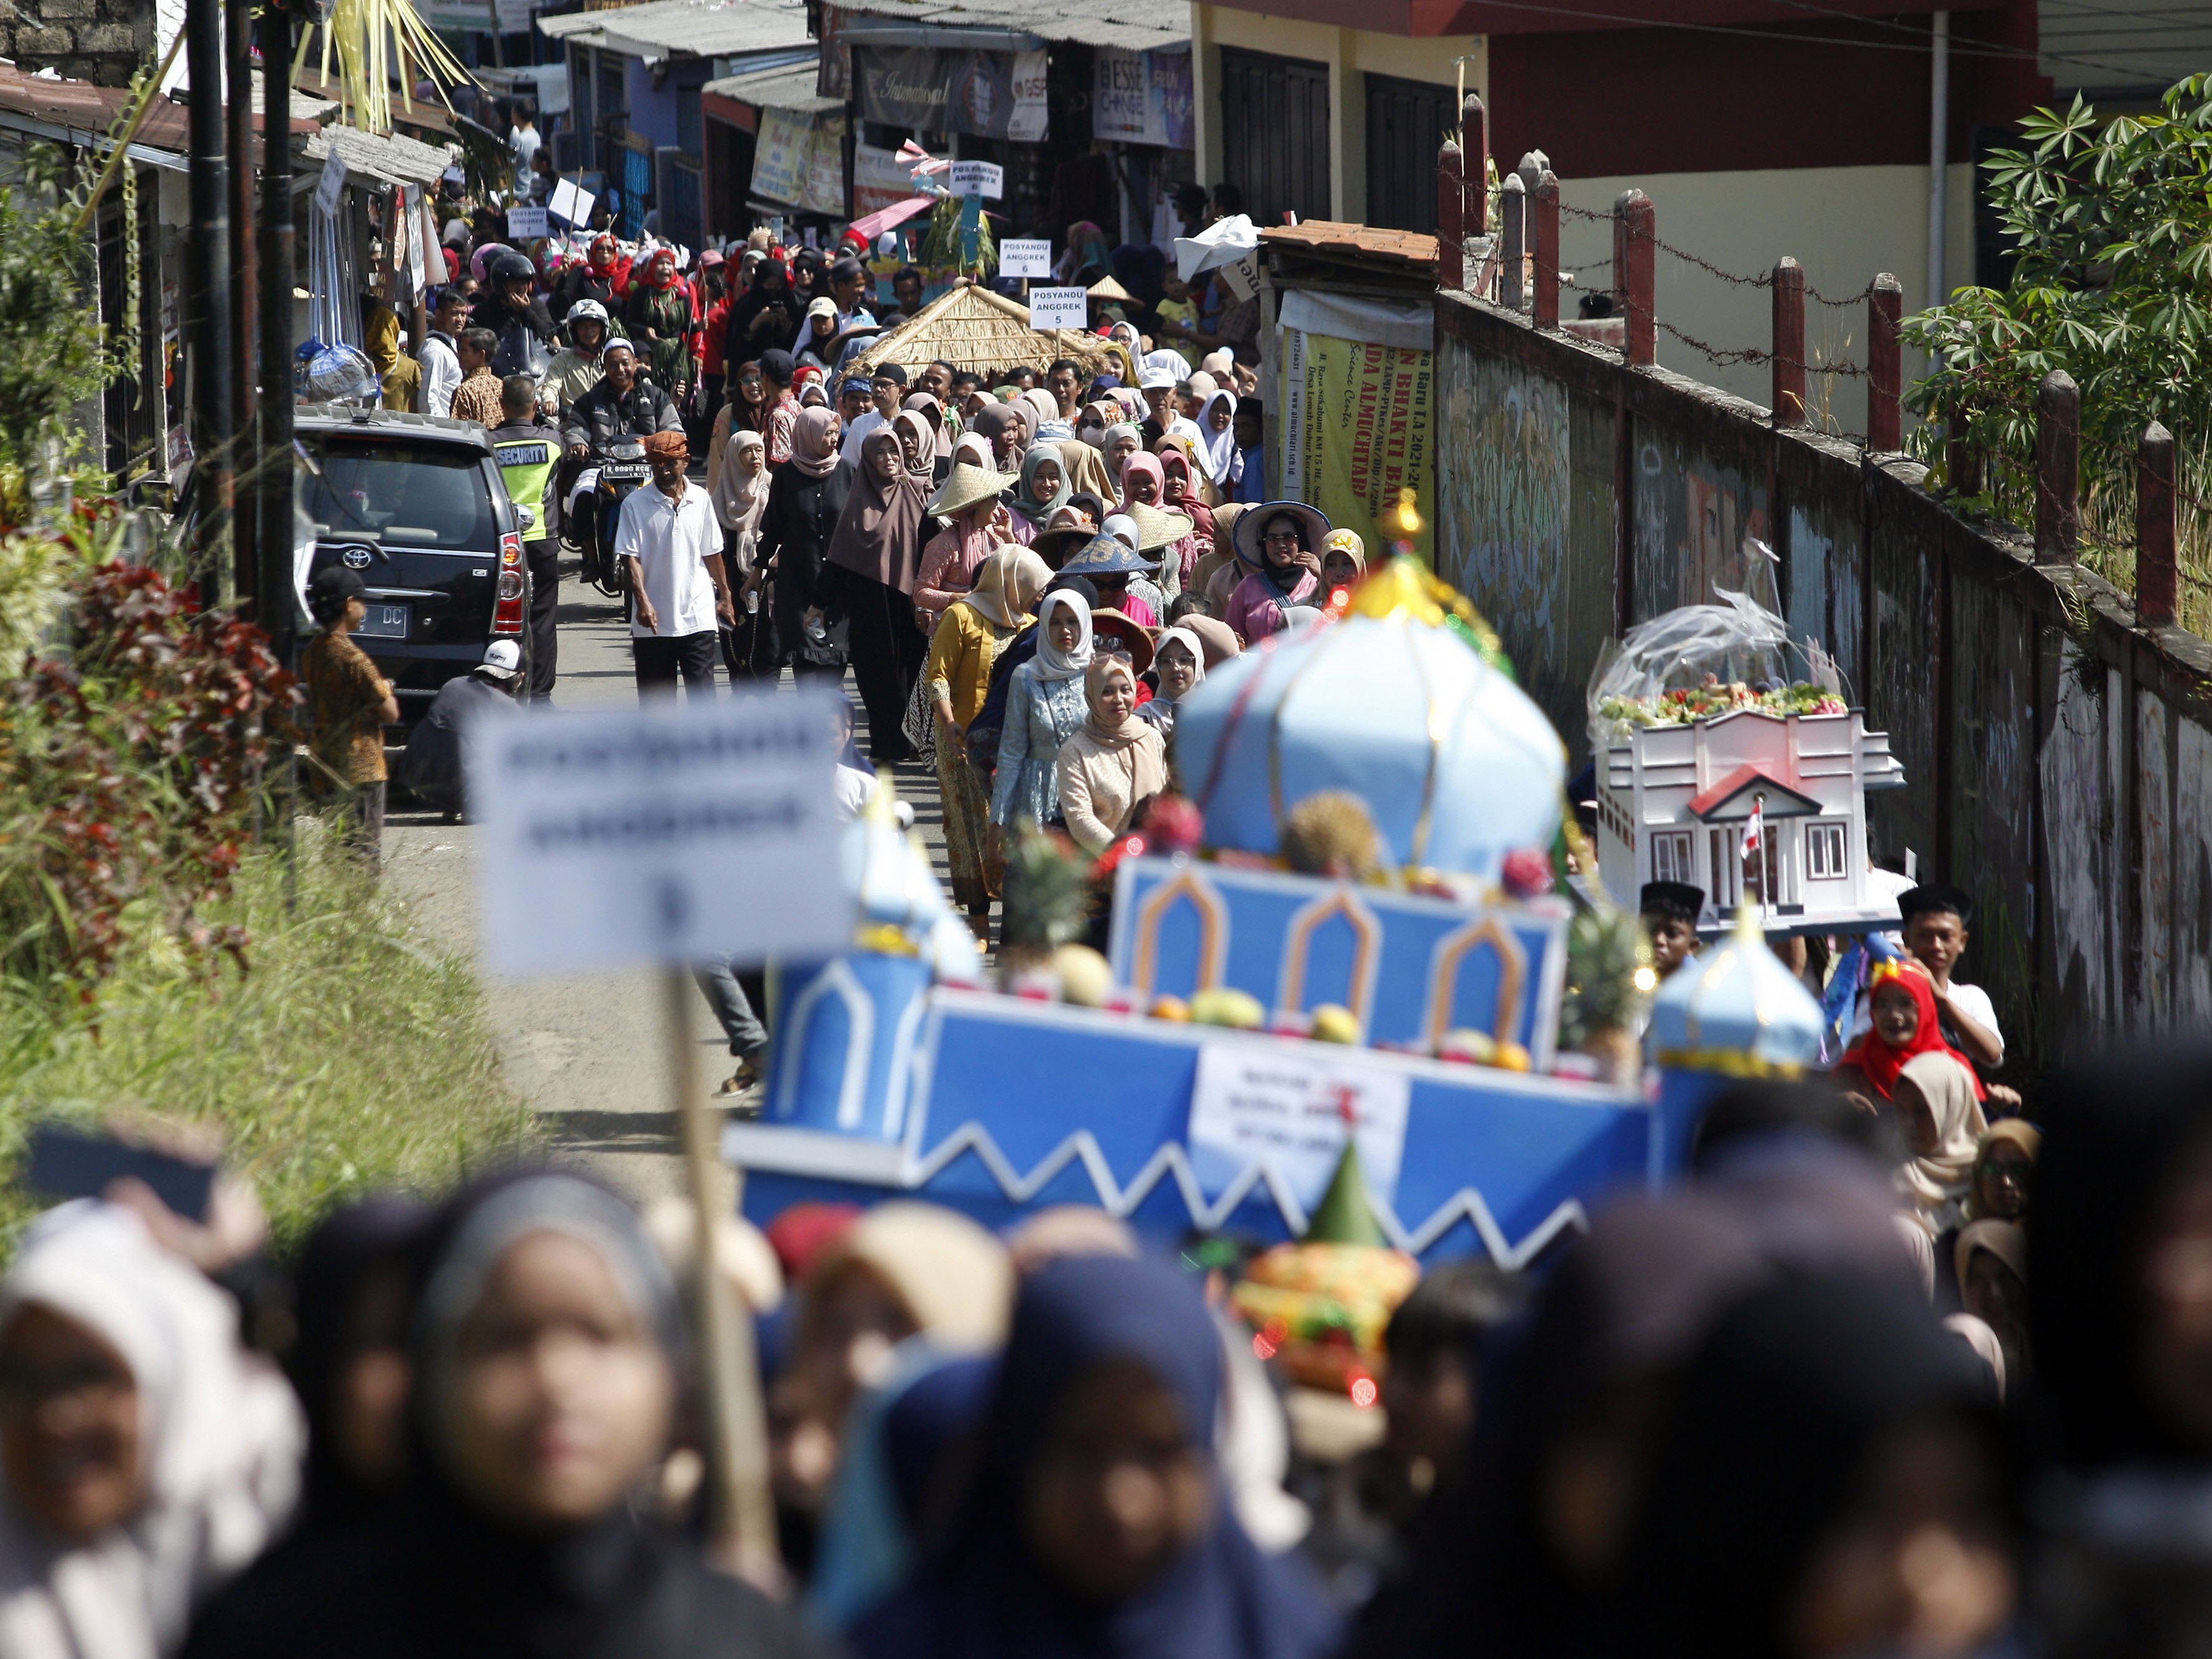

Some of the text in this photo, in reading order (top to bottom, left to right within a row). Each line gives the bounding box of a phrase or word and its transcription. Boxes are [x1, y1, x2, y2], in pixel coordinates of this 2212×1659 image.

[1034, 291, 1083, 299] POSYANDU
[1036, 303, 1081, 311] ANGGREK
[1055, 315, 1061, 323] 5
[1308, 366, 1316, 388] Desa
[1342, 343, 1362, 429] Science Center
[1415, 371, 1430, 406] Baru
[1306, 391, 1314, 421] Lemah
[1387, 373, 1413, 458] BHAKTI
[1412, 411, 1426, 429] T.A
[1305, 423, 1313, 453] Duhur
[1315, 436, 1323, 450] KM
[497, 444, 547, 465] SECURITY
[1314, 453, 1322, 465] 15
[383, 608, 402, 625] DC
